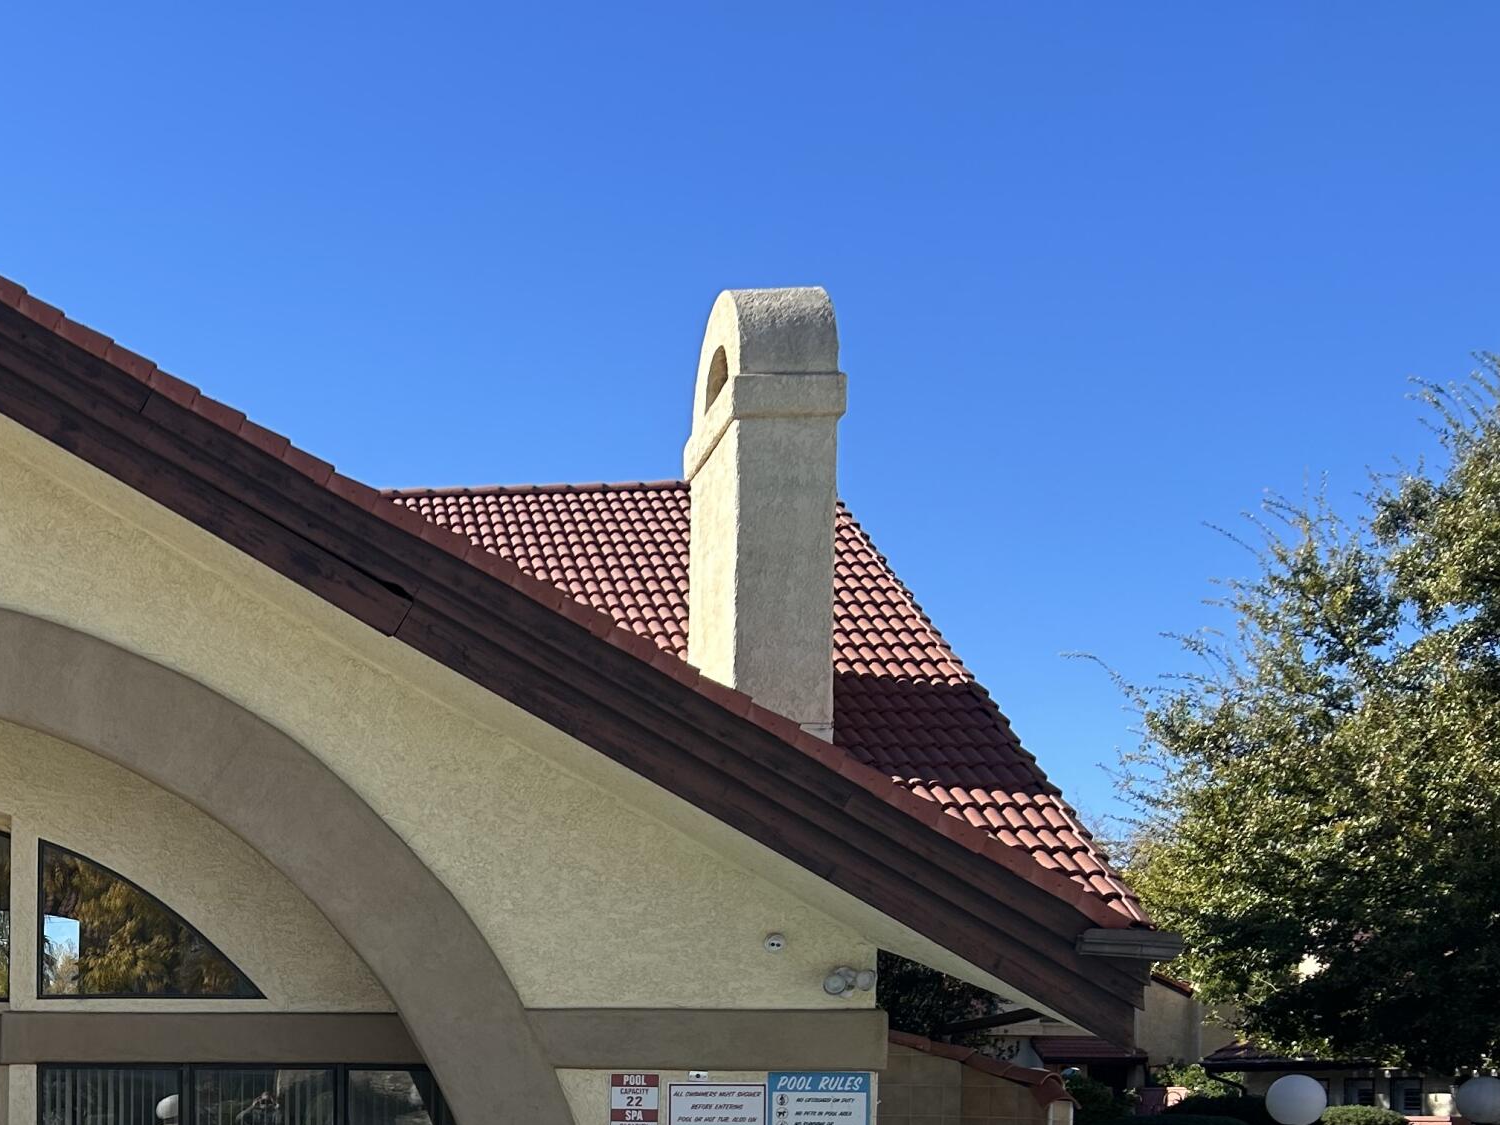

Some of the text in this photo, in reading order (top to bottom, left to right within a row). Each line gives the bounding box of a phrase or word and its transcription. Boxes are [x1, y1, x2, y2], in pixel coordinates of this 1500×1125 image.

[623, 1075, 647, 1085] POOL
[777, 1076, 863, 1090] POOL RULES
[626, 1096, 642, 1106] 22
[625, 1110, 643, 1120] SPA
